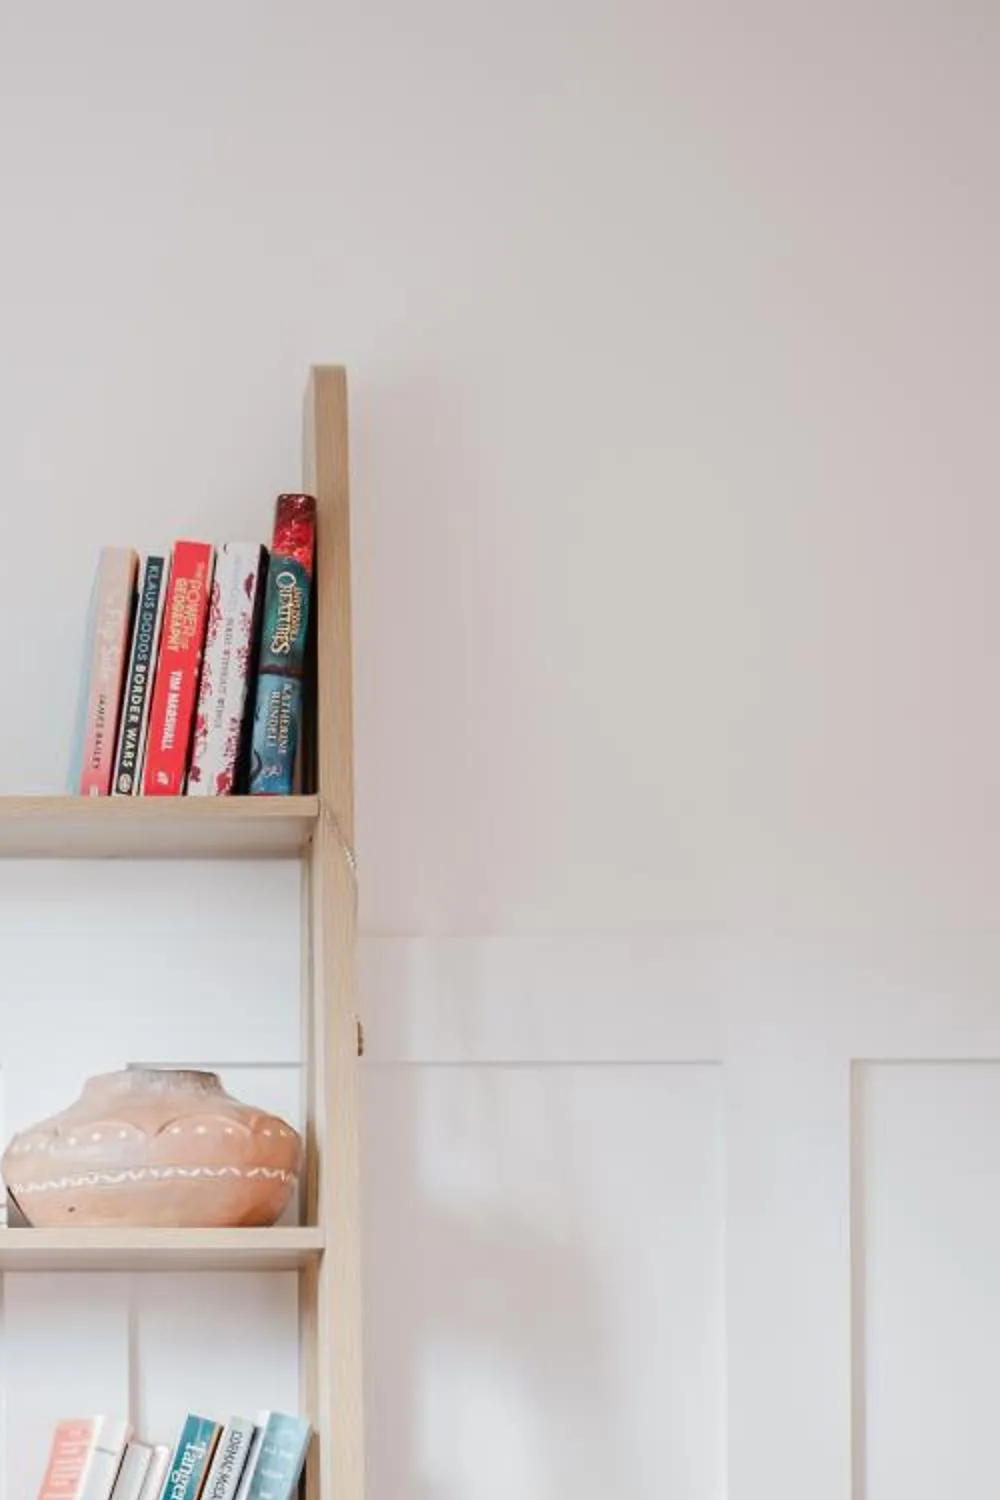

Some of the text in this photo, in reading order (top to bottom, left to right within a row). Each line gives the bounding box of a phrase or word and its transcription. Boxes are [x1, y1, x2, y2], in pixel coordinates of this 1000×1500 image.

[122, 564, 161, 769] KLAUS DODDS BORDER WARS
